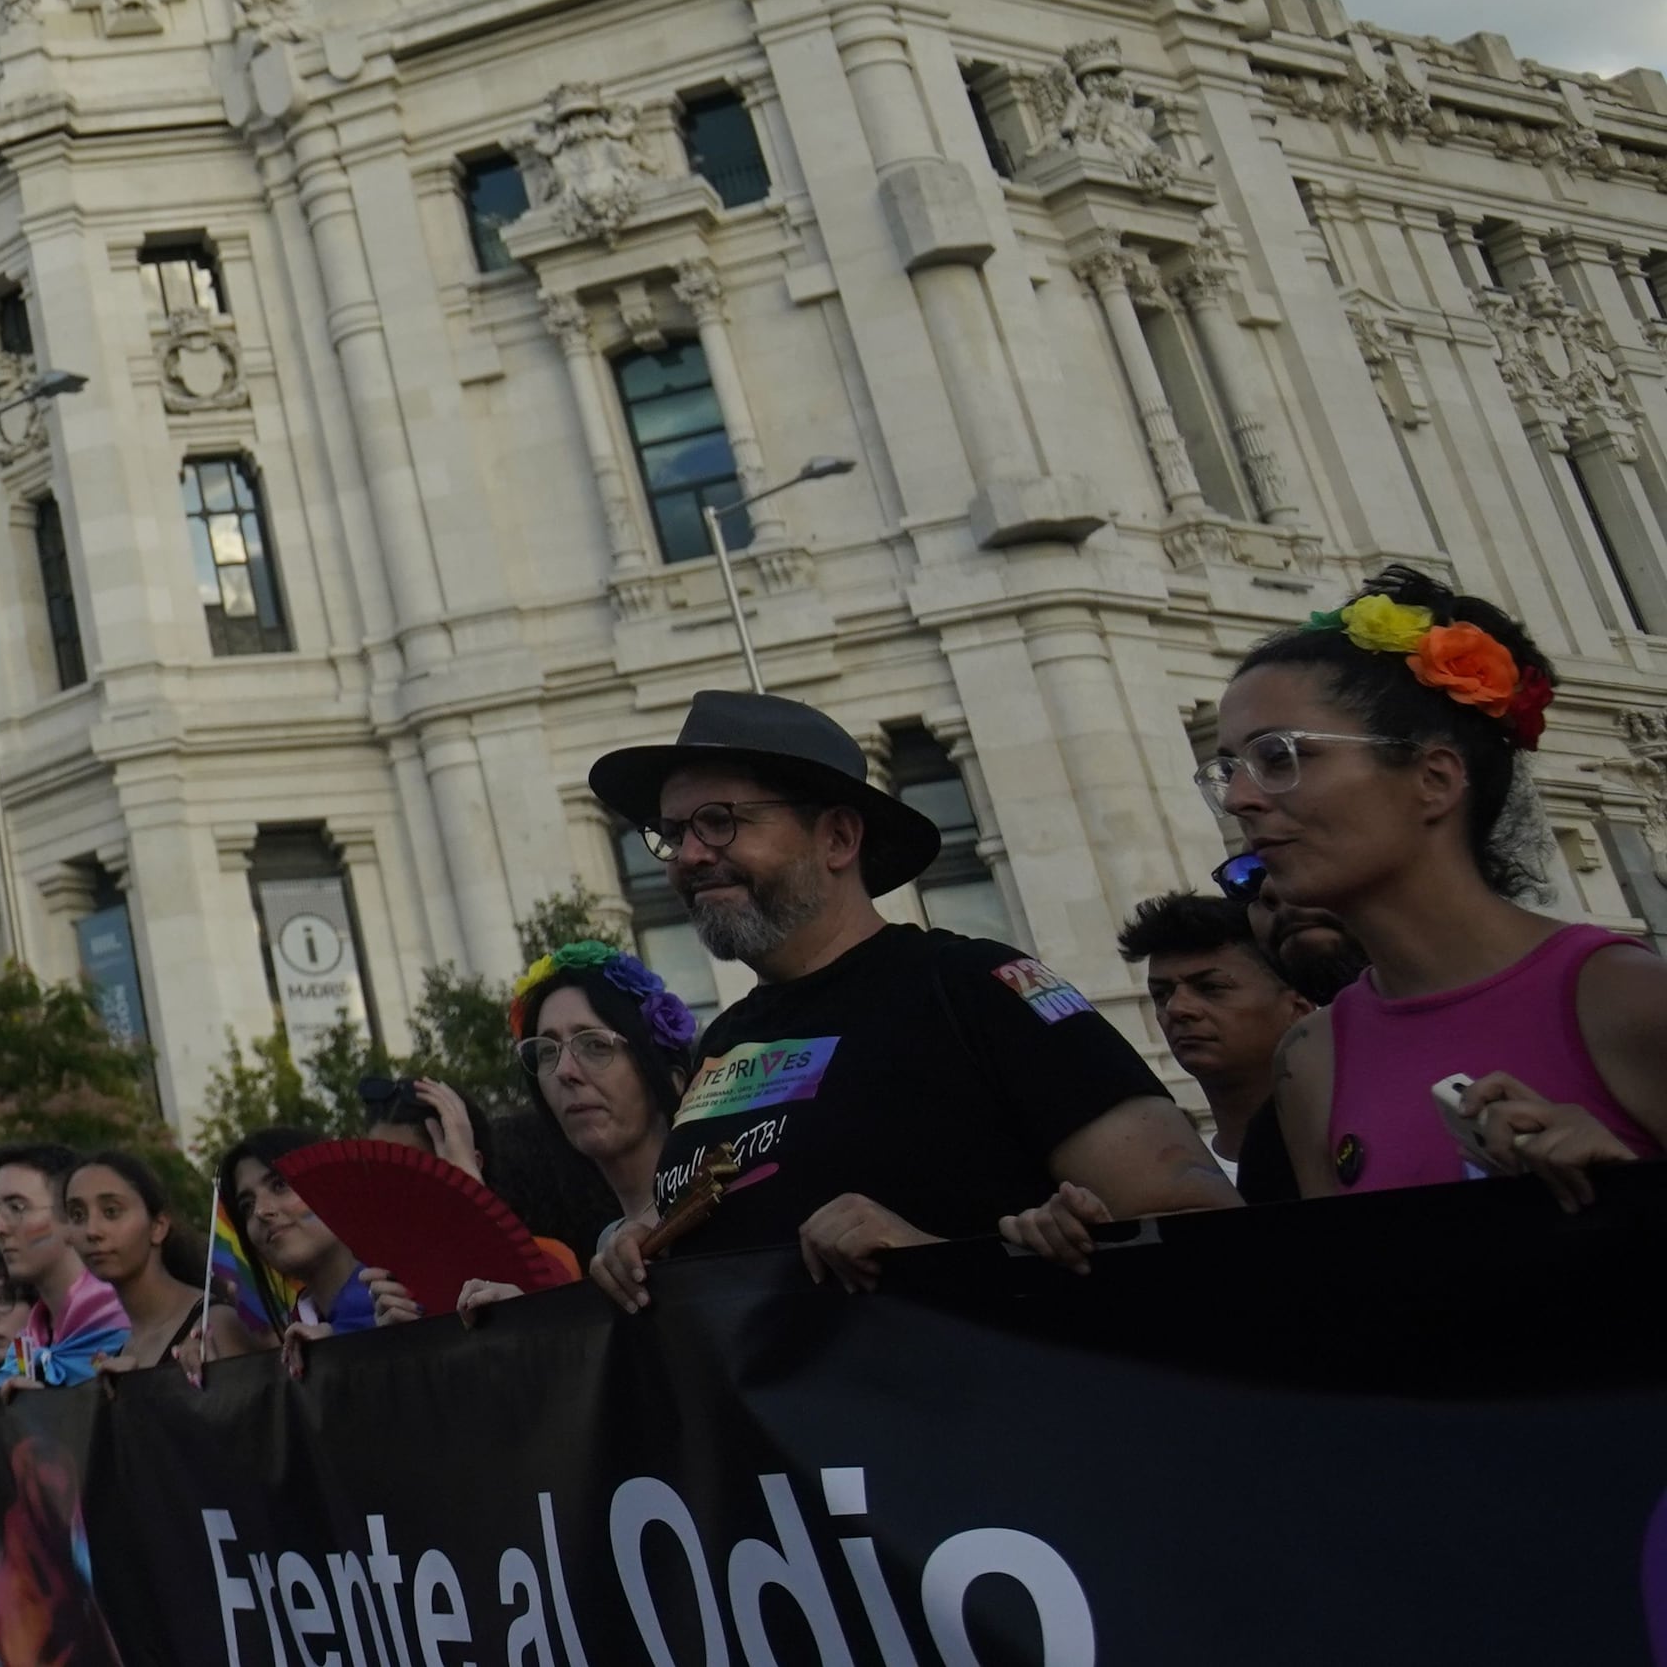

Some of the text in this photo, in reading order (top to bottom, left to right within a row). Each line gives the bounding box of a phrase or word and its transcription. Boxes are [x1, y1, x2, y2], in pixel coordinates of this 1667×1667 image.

[703, 1066, 725, 1086] TE
[656, 1114, 787, 1206] rgull GTB!
[200, 1466, 1096, 1667] Frente al Odio
